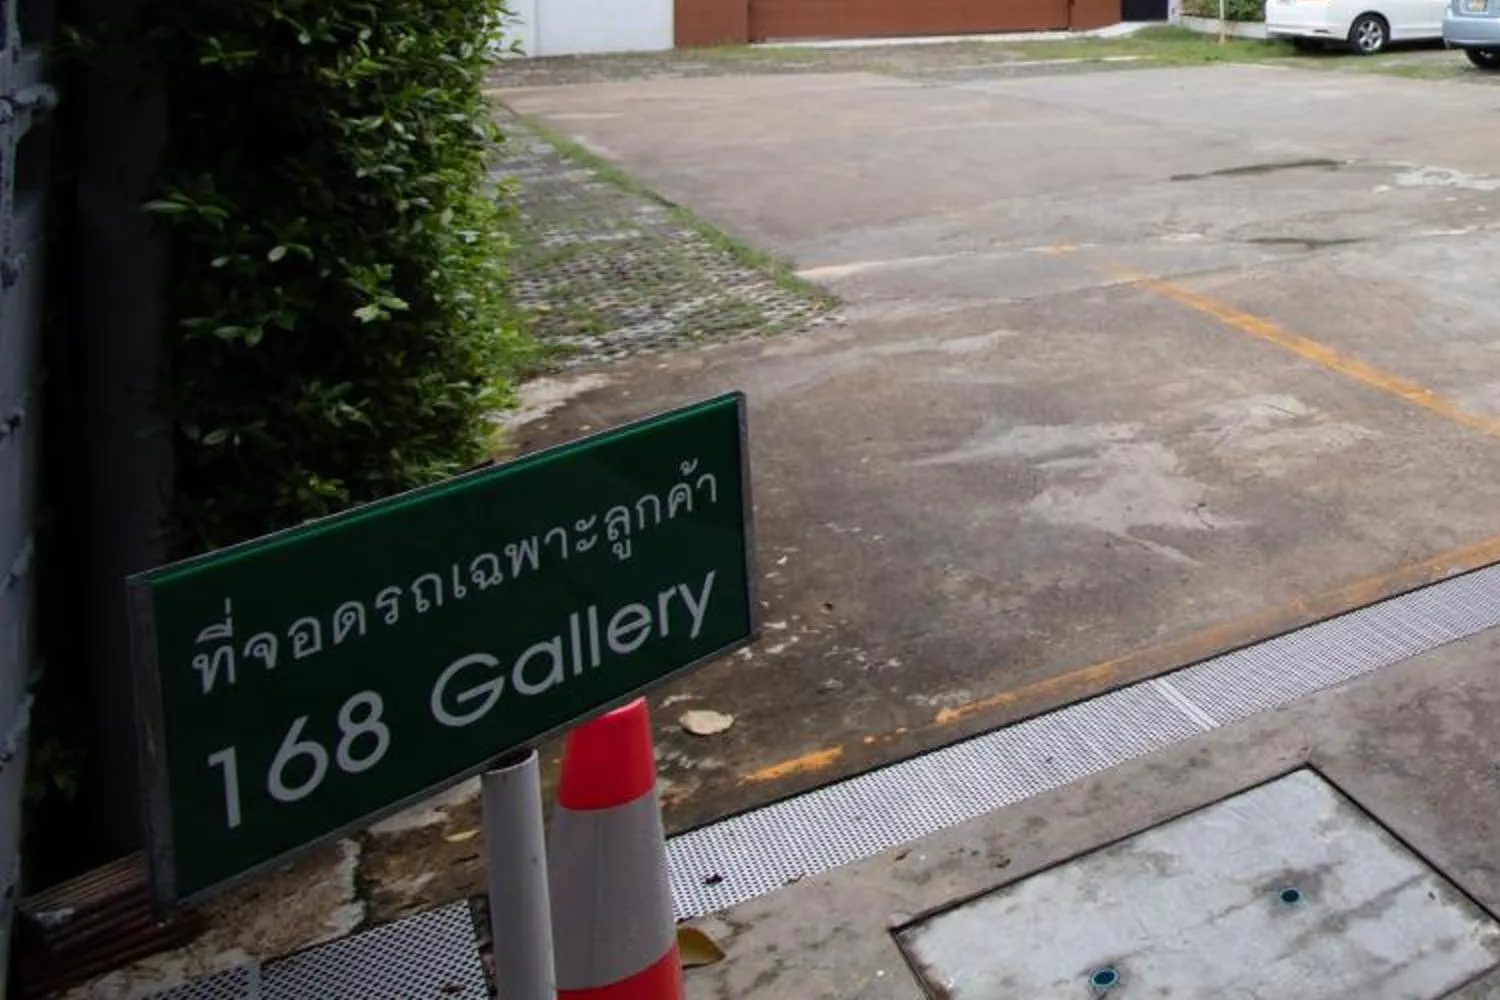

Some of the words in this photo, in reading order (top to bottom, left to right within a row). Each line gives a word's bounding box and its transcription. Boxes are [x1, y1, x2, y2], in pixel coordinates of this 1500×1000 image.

[191, 458, 718, 694] ที่จอดรถเฉพาะลูกค้า
[207, 690, 390, 828] 168
[430, 570, 716, 728] Gallery
